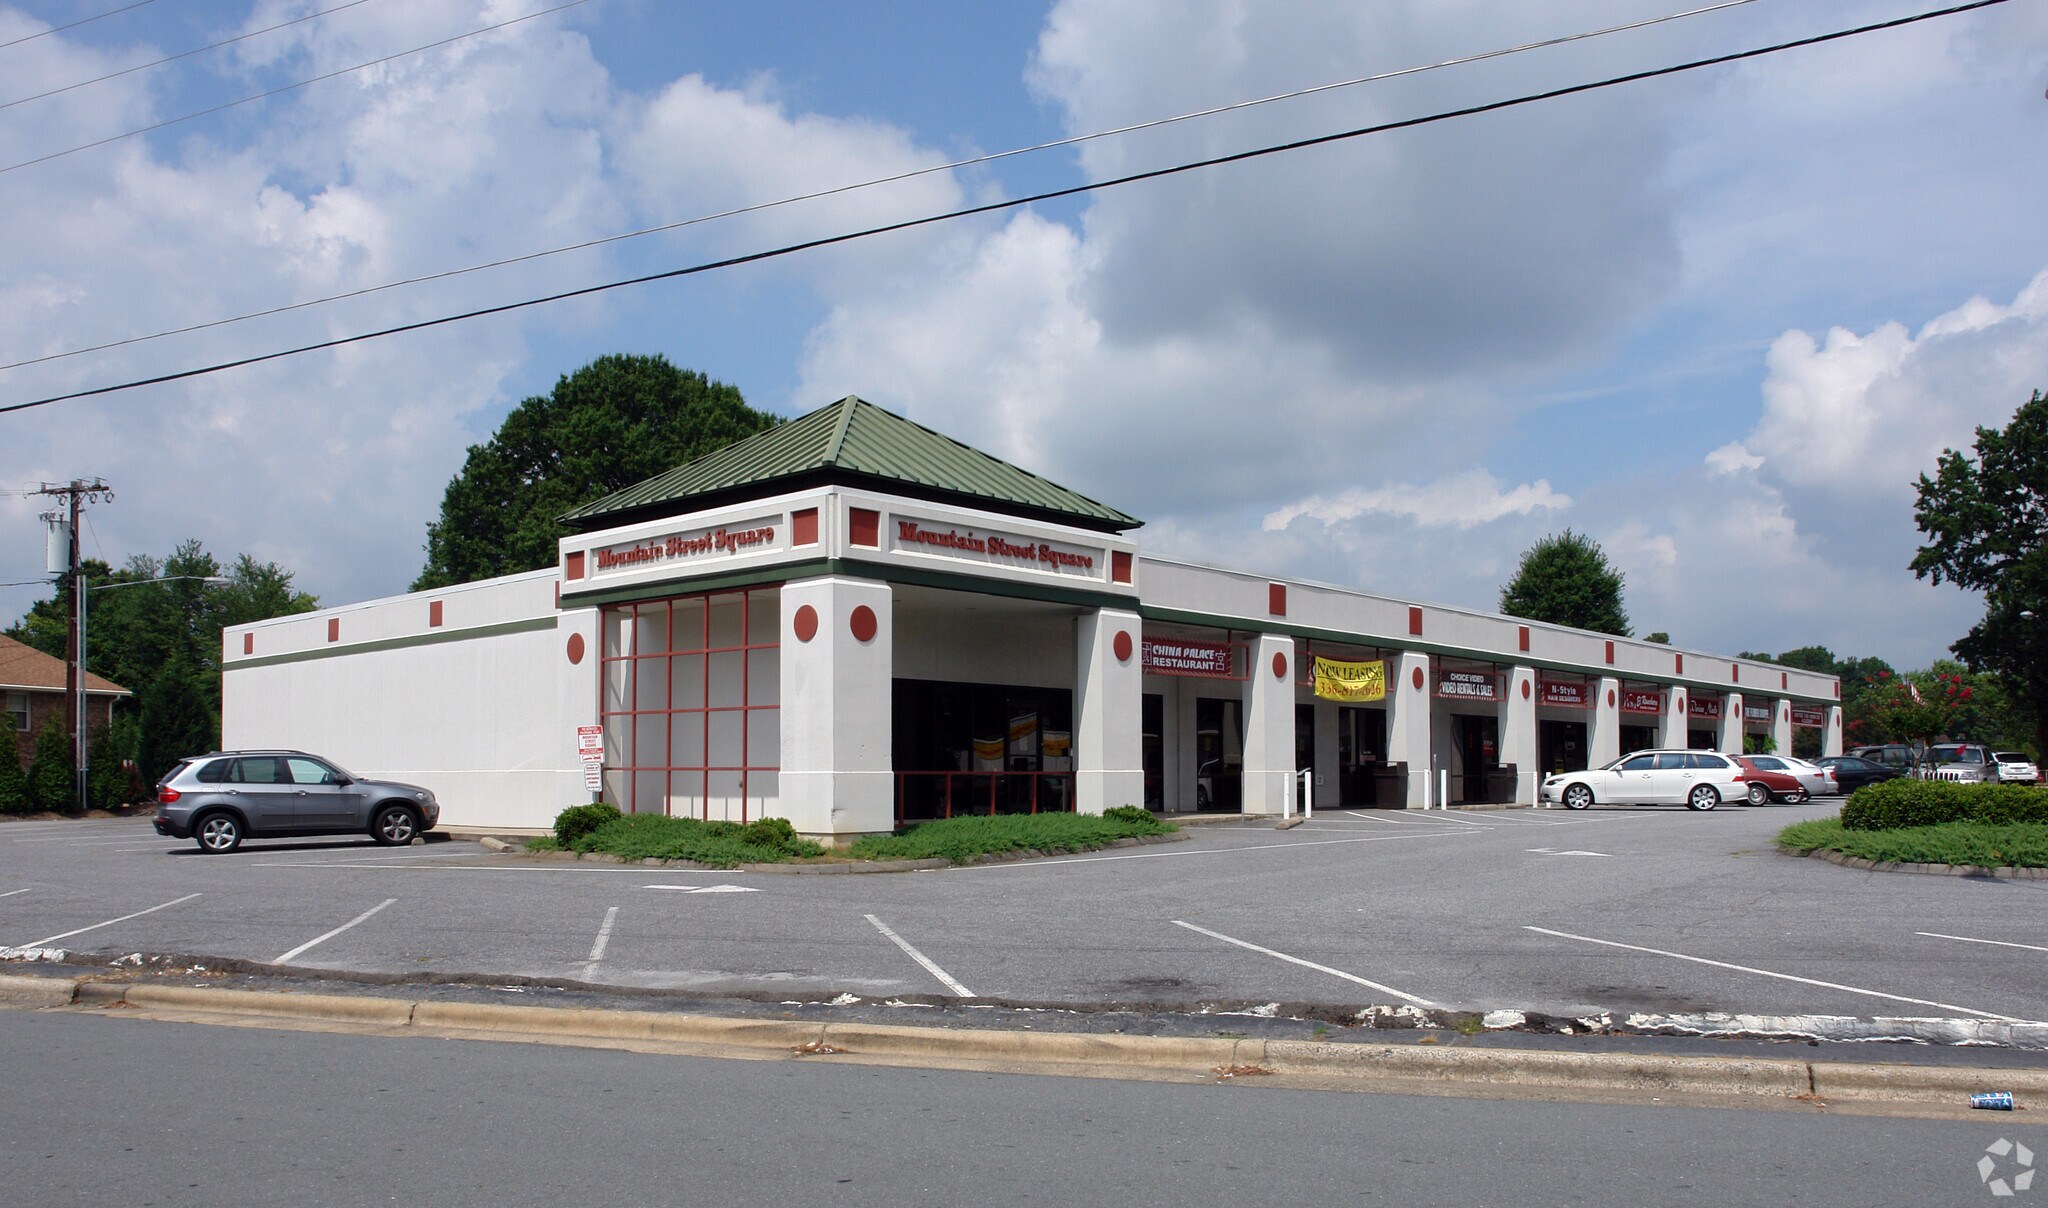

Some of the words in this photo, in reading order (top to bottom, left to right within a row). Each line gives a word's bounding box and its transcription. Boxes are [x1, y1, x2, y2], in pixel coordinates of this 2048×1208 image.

[597, 541, 663, 568] Mountain
[665, 531, 713, 556] Street
[714, 526, 775, 555] Square
[898, 521, 986, 553] Mountain
[987, 536, 1037, 560] Street
[1038, 543, 1093, 569] Square
[1152, 644, 1182, 657] CHINA
[1183, 648, 1215, 660] PALACE
[1152, 656, 1215, 670] RESTAURANT
[1317, 661, 1341, 678] NOW
[1343, 664, 1383, 681] LEASING
[1450, 672, 1469, 682] CHOICE
[1469, 674, 1485, 683] VIDEO
[1441, 681, 1456, 694] VIDEO
[1457, 682, 1476, 695] RENTALS
[1480, 684, 1493, 697] SALES
[1551, 684, 1577, 696] N-Style
